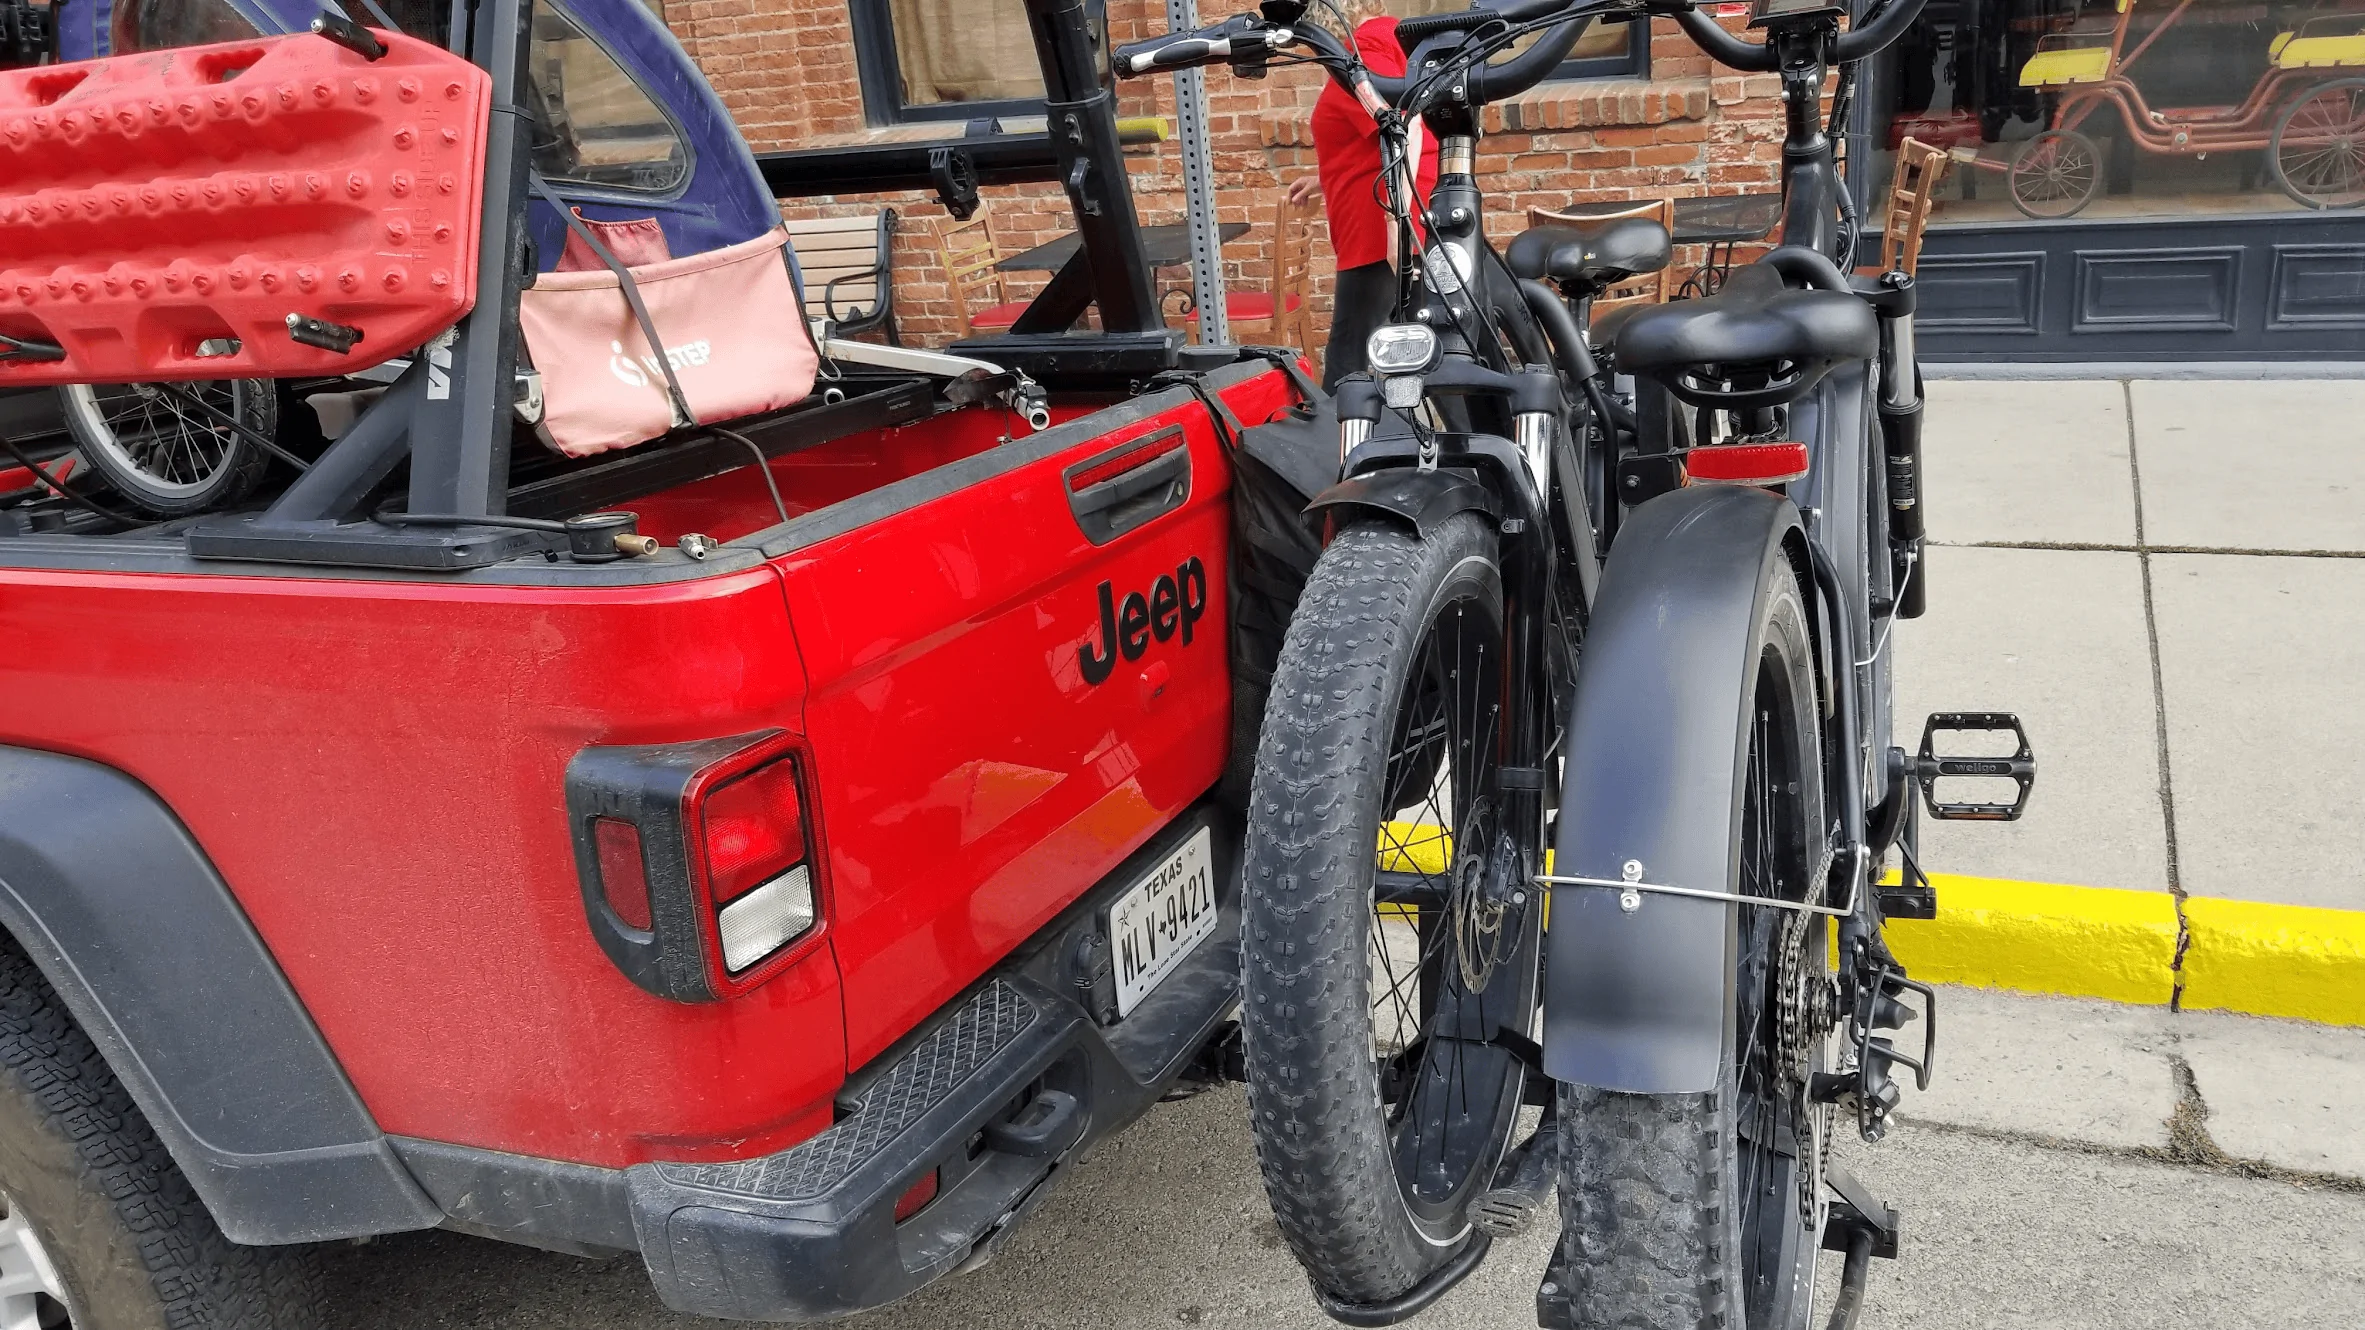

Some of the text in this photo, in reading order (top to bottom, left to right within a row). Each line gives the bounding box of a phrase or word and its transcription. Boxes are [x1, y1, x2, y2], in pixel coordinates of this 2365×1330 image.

[411, 208, 432, 264] THIS
[1078, 555, 1207, 686] Jeep
[1954, 762, 1997, 774] wellgo
[1144, 856, 1183, 903] TEXAS
[1121, 866, 1210, 987] MLV 9421
[1147, 934, 1193, 981] The Lone Star State
